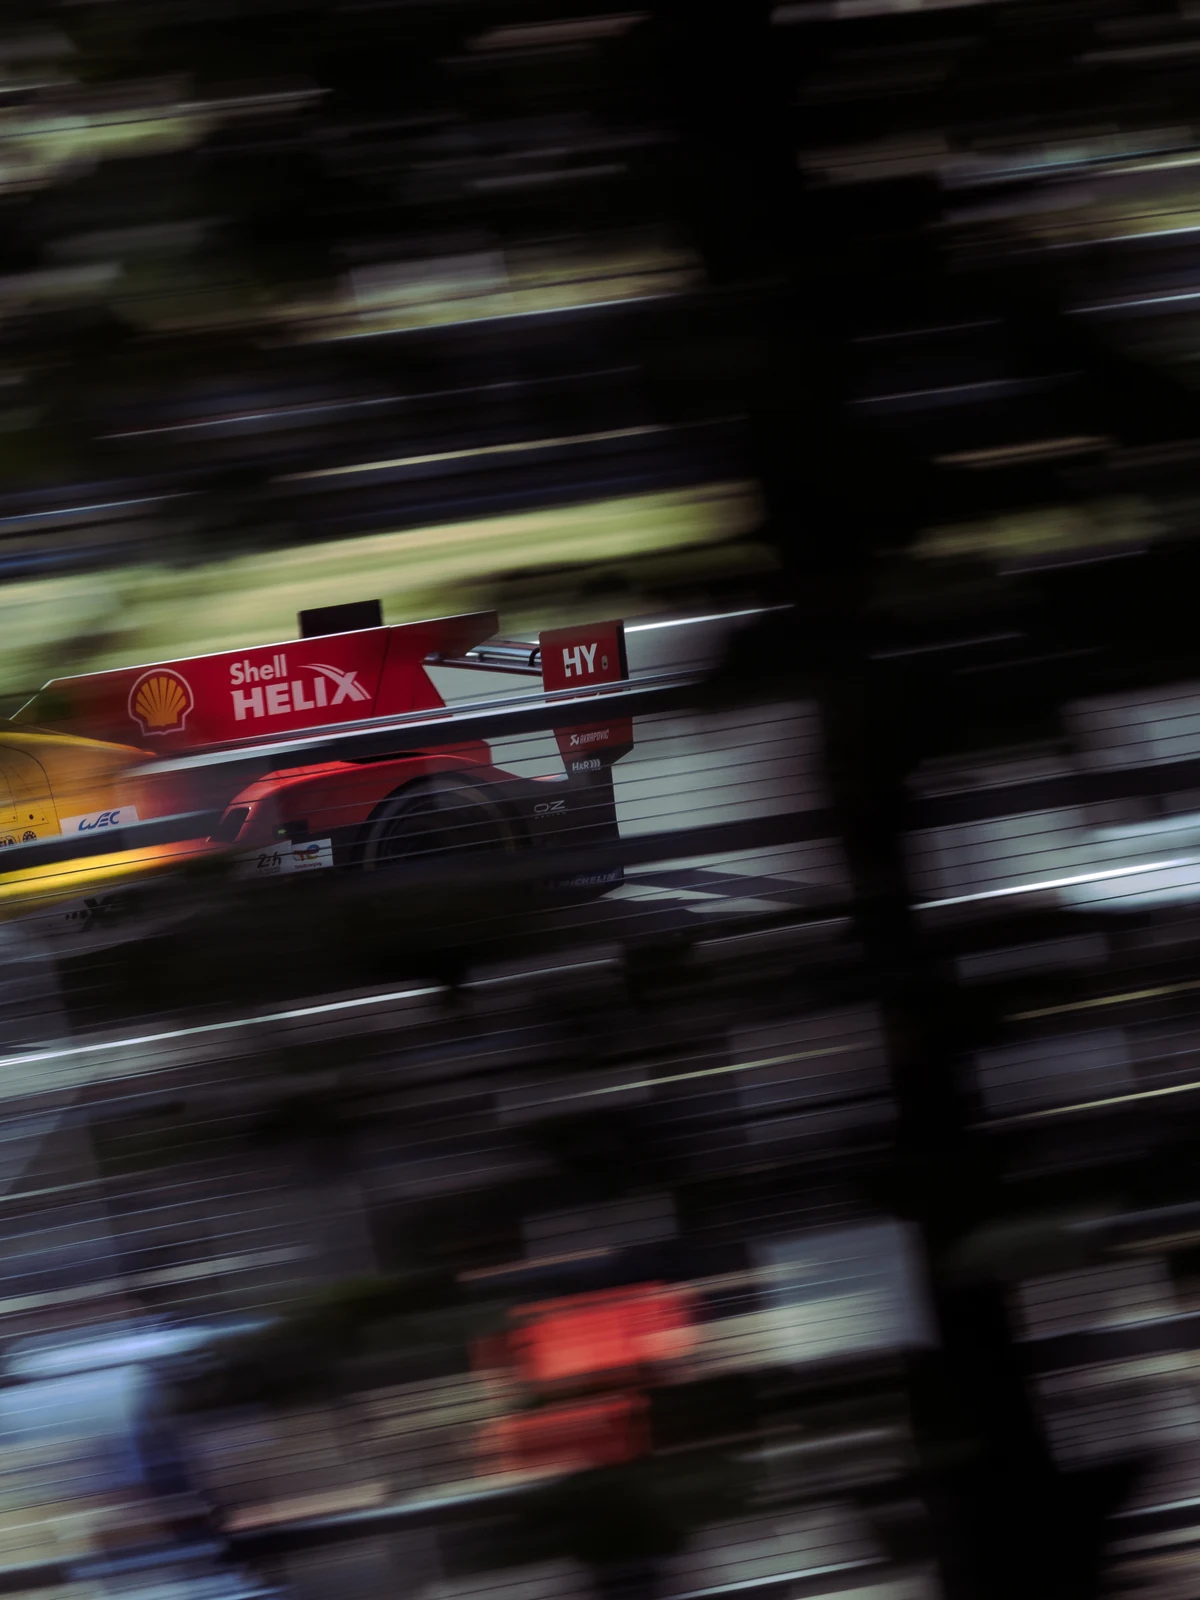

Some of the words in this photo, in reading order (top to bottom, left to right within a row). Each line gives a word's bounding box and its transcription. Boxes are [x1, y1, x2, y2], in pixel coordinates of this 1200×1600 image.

[229, 653, 288, 686] Shell
[562, 643, 598, 678] HY
[229, 663, 373, 722] HELIX
[533, 799, 566, 814] OZ
[78, 810, 121, 832] WEC
[557, 872, 616, 889] MICHELIN
